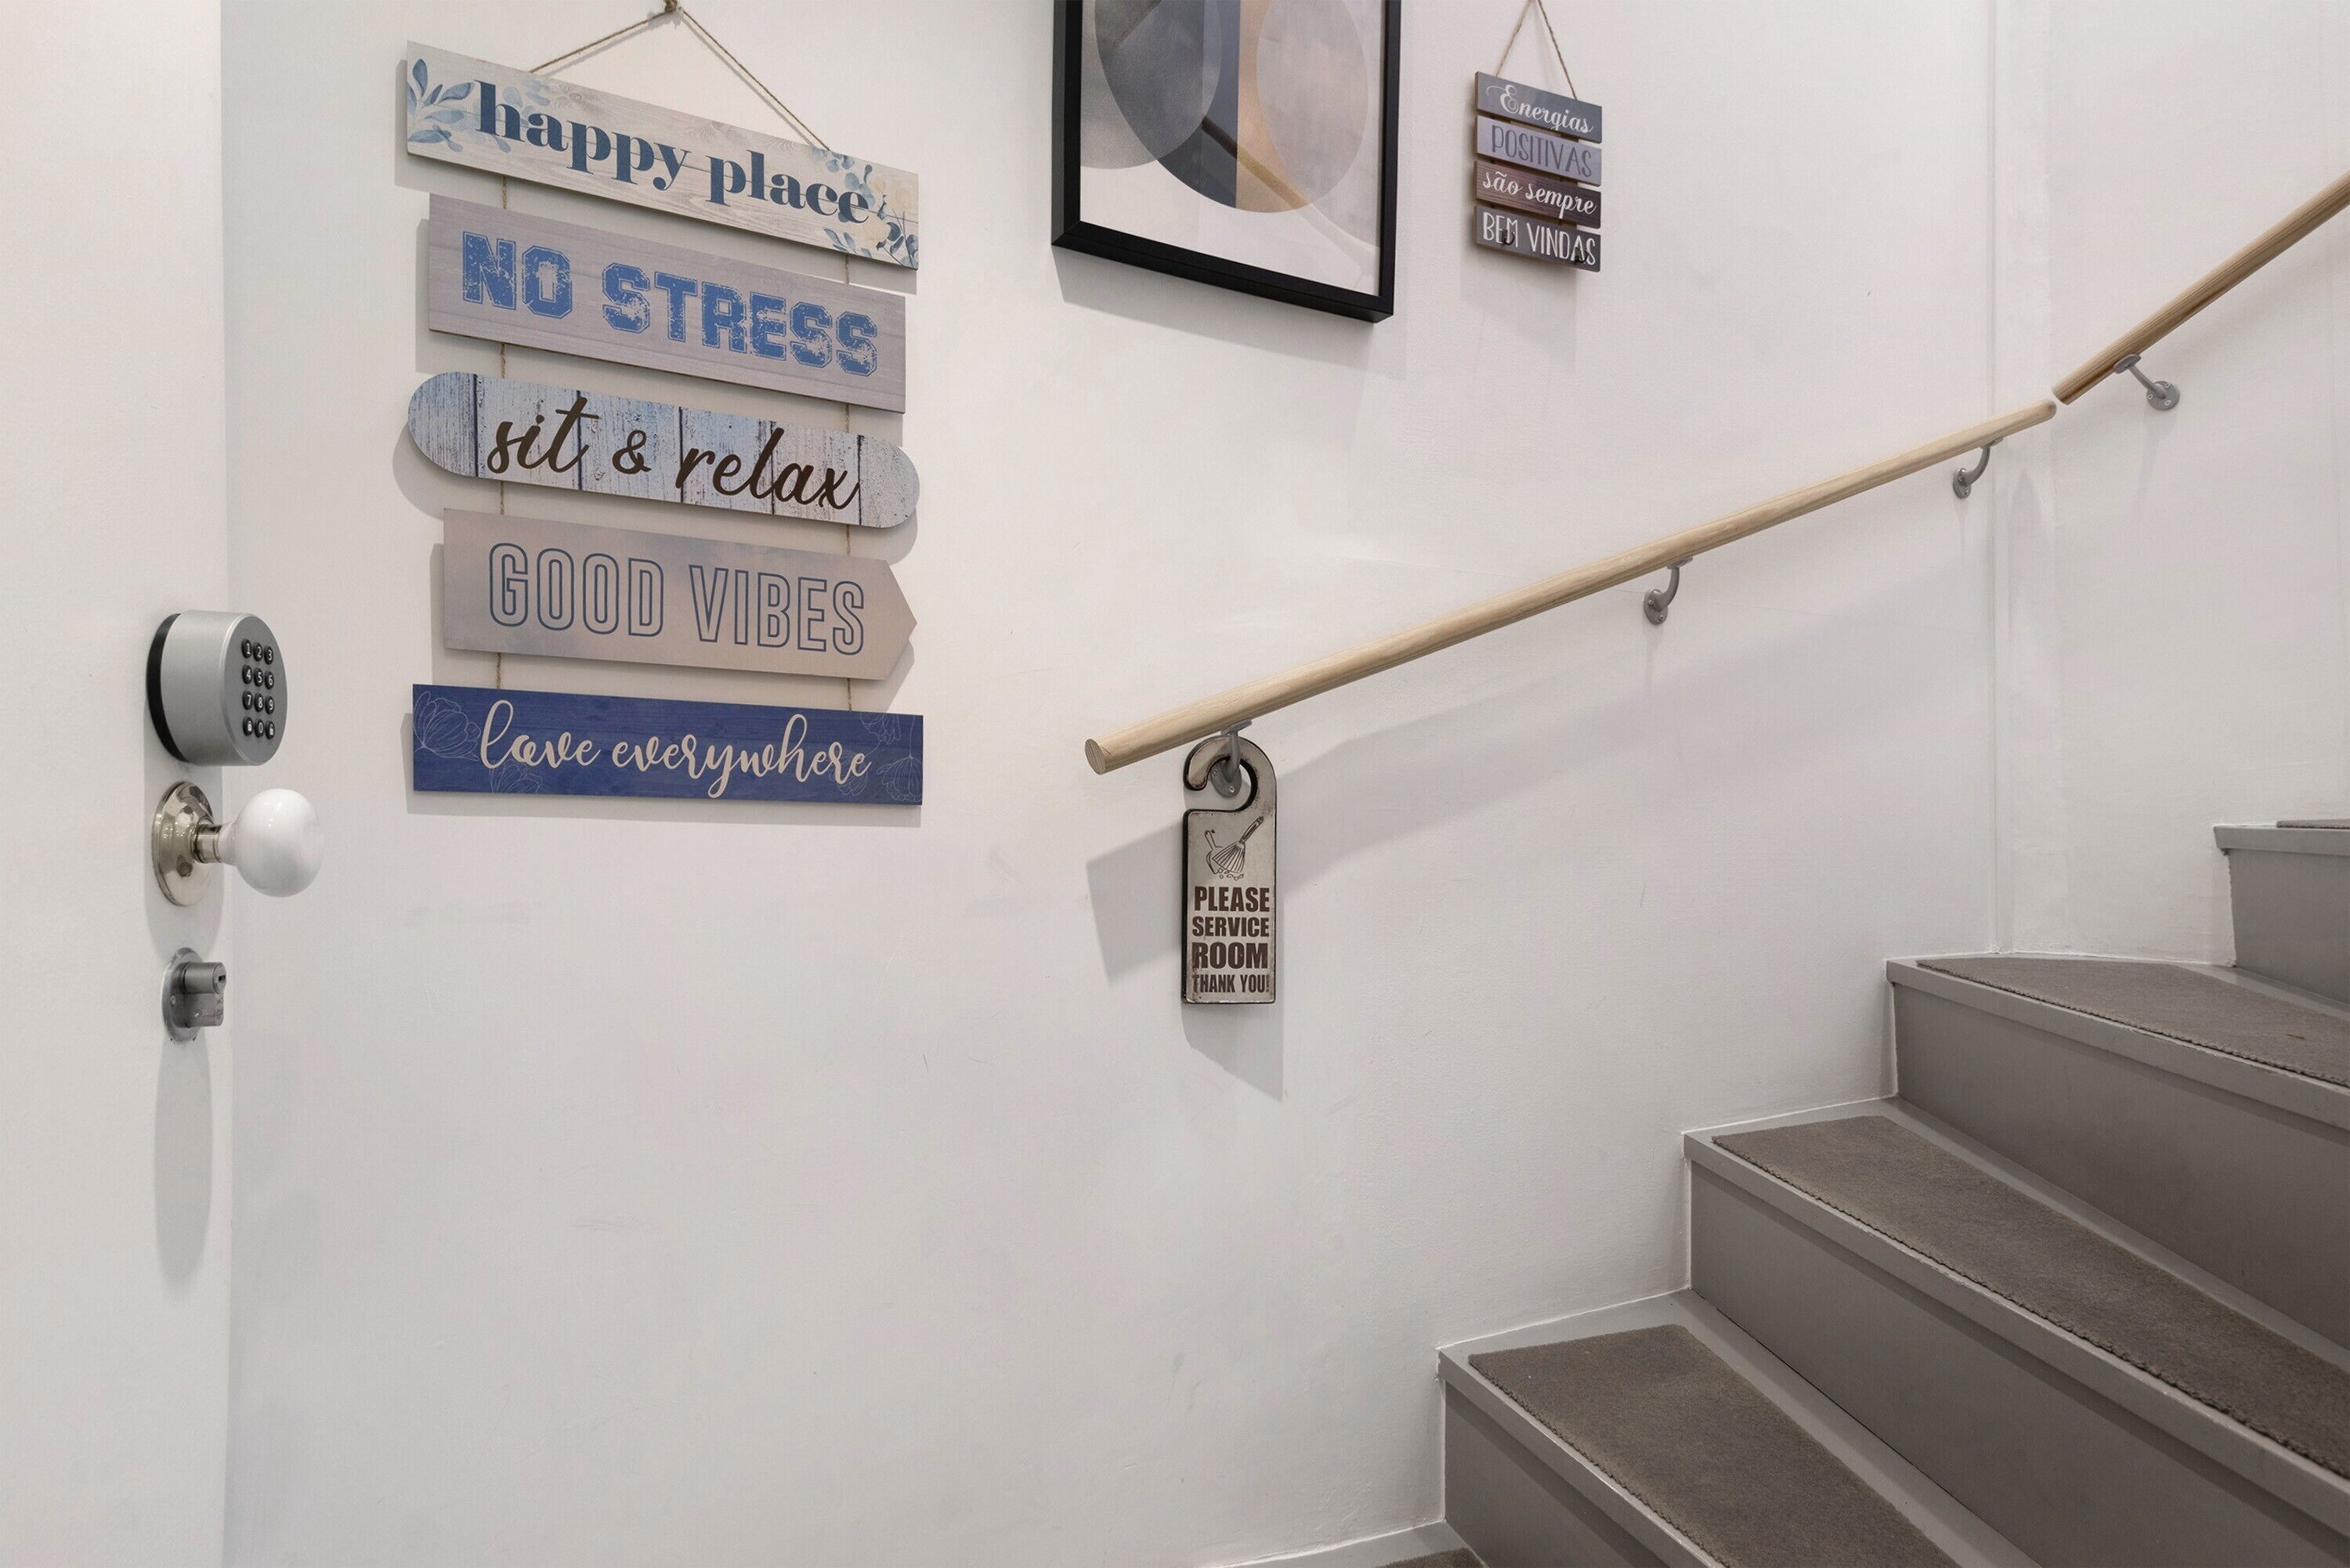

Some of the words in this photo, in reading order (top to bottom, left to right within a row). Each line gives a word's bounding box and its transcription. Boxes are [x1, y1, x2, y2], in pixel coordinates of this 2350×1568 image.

[1486, 84, 1594, 133] Energias
[474, 79, 692, 192] happy
[705, 150, 870, 223] place
[1491, 124, 1593, 178] POSITIVAS
[1482, 171, 1523, 195] são
[1525, 182, 1597, 219] sempre
[1483, 211, 1519, 247] BEM
[1526, 222, 1596, 266] VINDAS
[462, 231, 573, 320] NO
[602, 262, 878, 378] STRESS
[486, 396, 602, 474] sit
[612, 428, 652, 475] &
[674, 427, 862, 510] relax
[488, 542, 665, 638] GOOD
[689, 564, 865, 656] VIBES
[480, 699, 602, 769] love
[611, 713, 872, 798] everywhere
[1194, 886, 1270, 912] PLEASE
[1191, 916, 1270, 938] SERVICE
[1191, 941, 1268, 970] ROOM
[1192, 974, 1236, 993] THANK
[1240, 974, 1270, 993] YOU!
